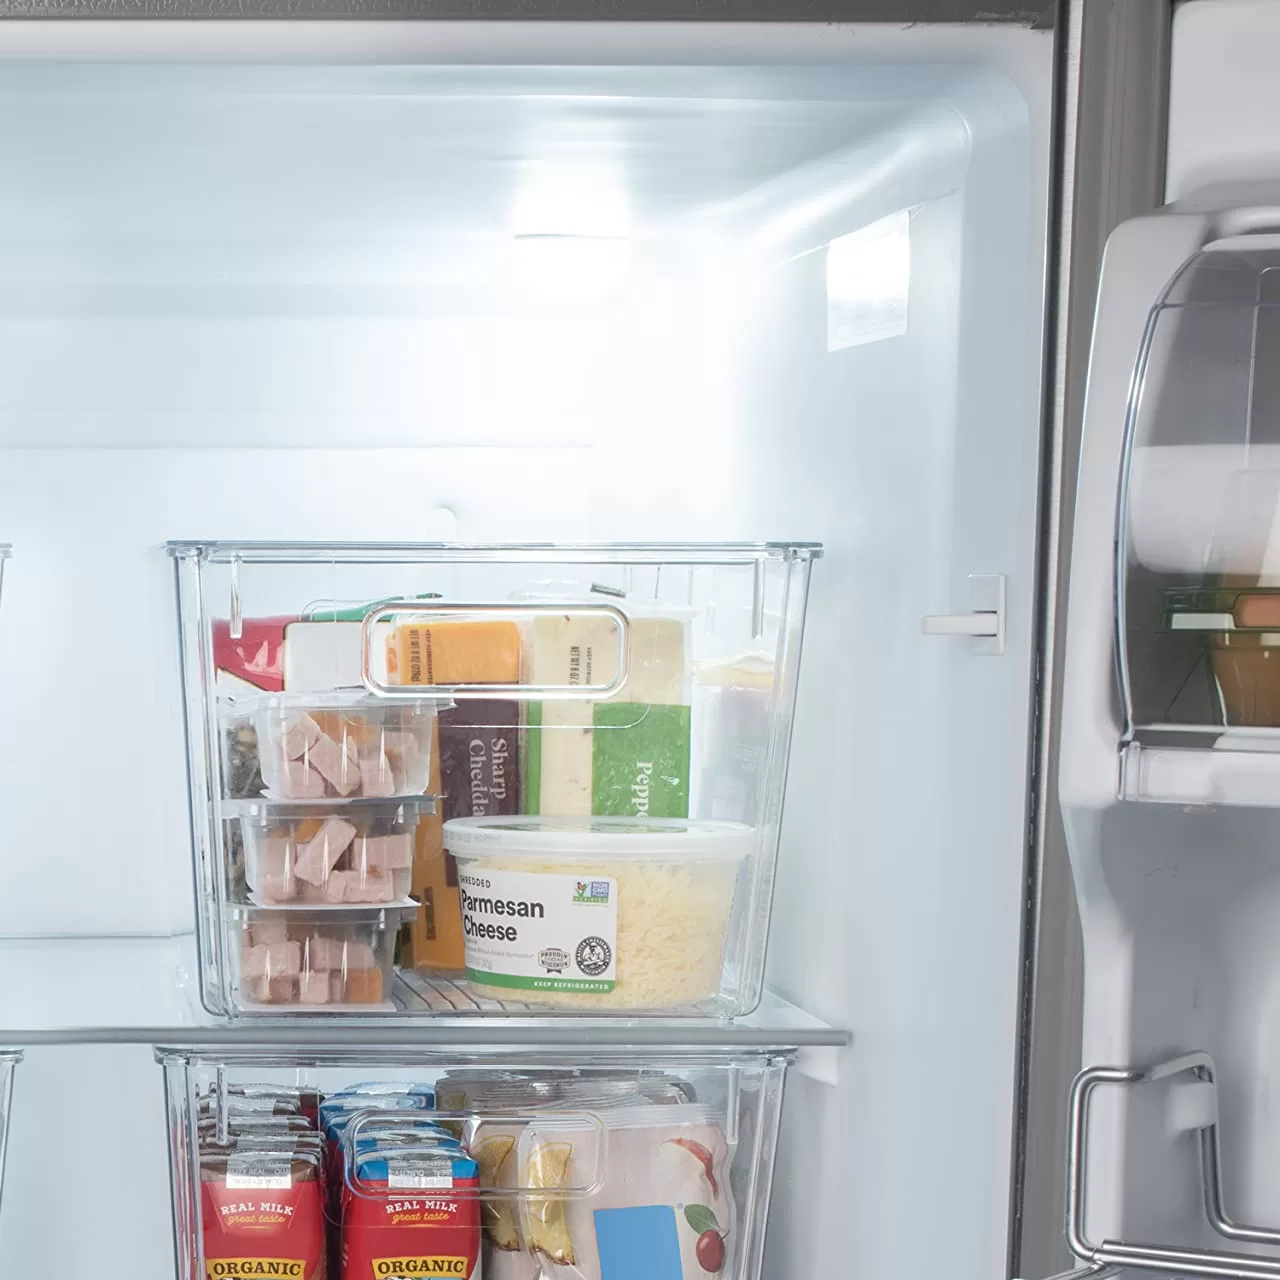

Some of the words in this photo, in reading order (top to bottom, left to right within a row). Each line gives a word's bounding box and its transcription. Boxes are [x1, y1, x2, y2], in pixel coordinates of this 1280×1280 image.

[490, 738, 509, 800] Sharp
[469, 738, 489, 817] Chedda
[461, 889, 545, 918] Parmesan
[463, 915, 518, 942] Cheese
[553, 982, 609, 990] REFRIGERATED
[220, 1202, 255, 1216] REAL
[260, 1202, 294, 1216] MILK
[385, 1200, 420, 1214] REAL
[424, 1200, 458, 1213] MILK
[226, 1214, 256, 1227] great
[258, 1214, 286, 1223] taste
[391, 1213, 422, 1225] great
[423, 1212, 450, 1221] taste
[213, 1261, 301, 1276] ORGANIC
[377, 1259, 465, 1274] ORGANIC
